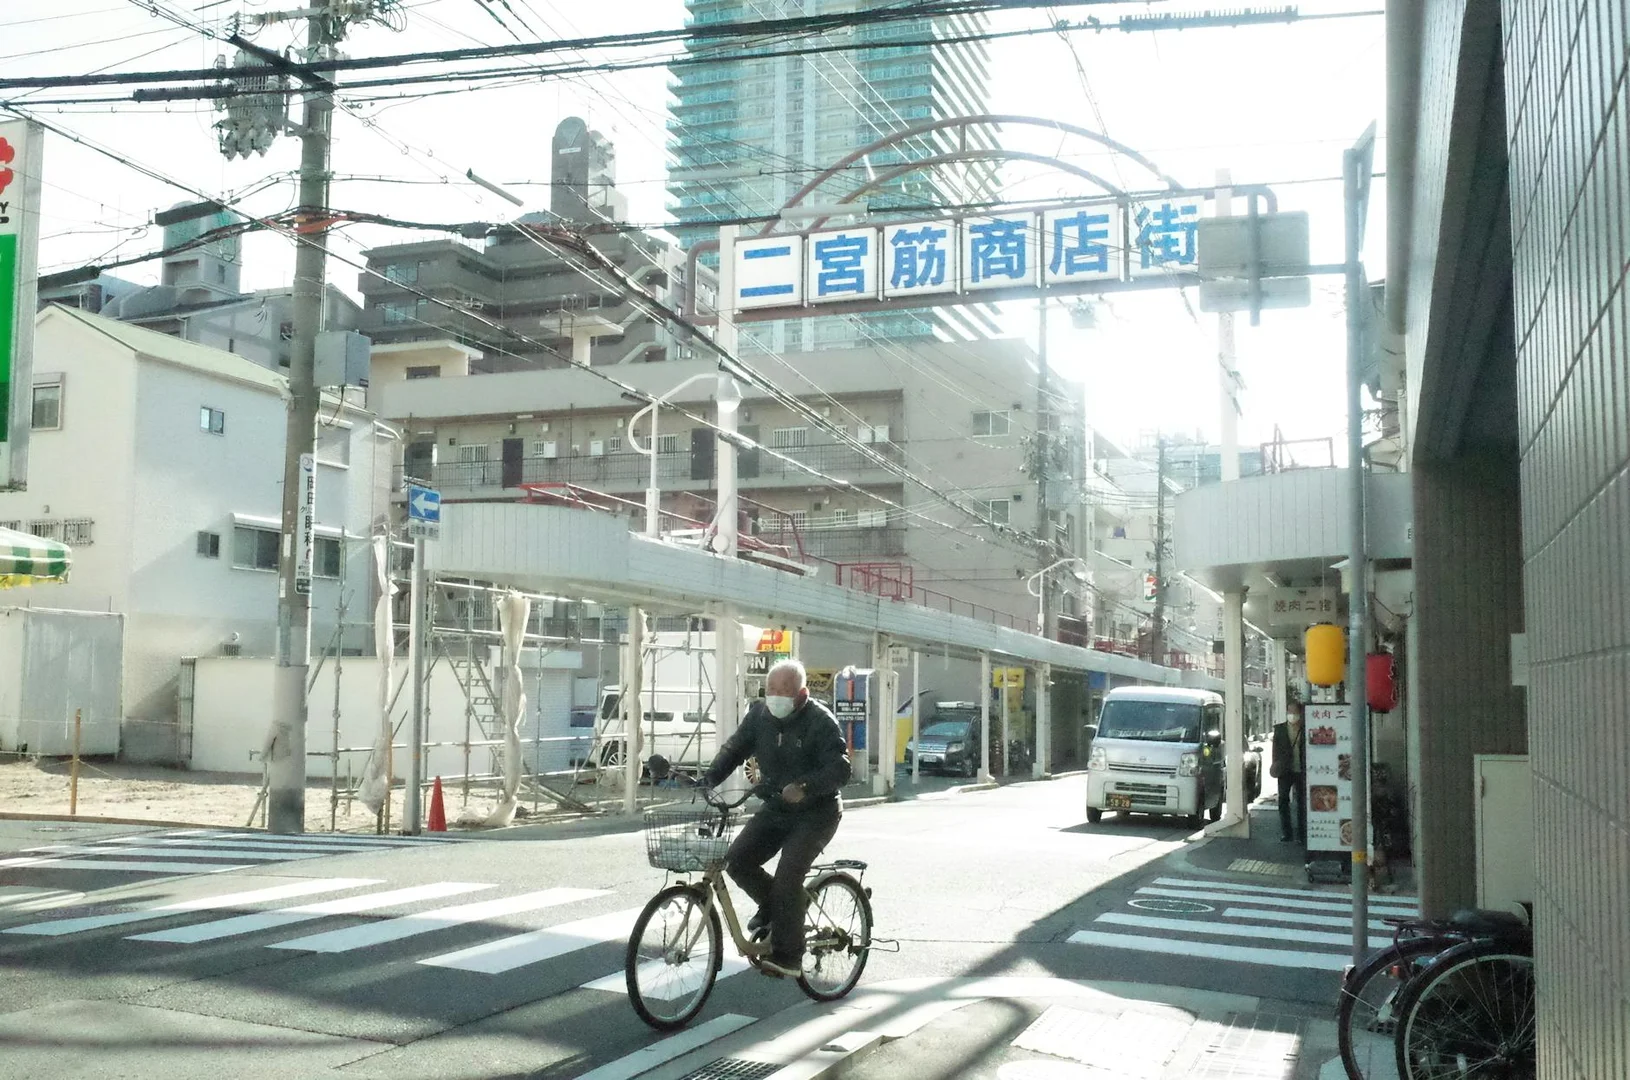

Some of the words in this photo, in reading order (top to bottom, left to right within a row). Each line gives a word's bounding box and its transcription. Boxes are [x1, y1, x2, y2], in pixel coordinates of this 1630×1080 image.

[740, 203, 1198, 298] 二宮筋商店街
[1312, 708, 1351, 719] 焼肉二
